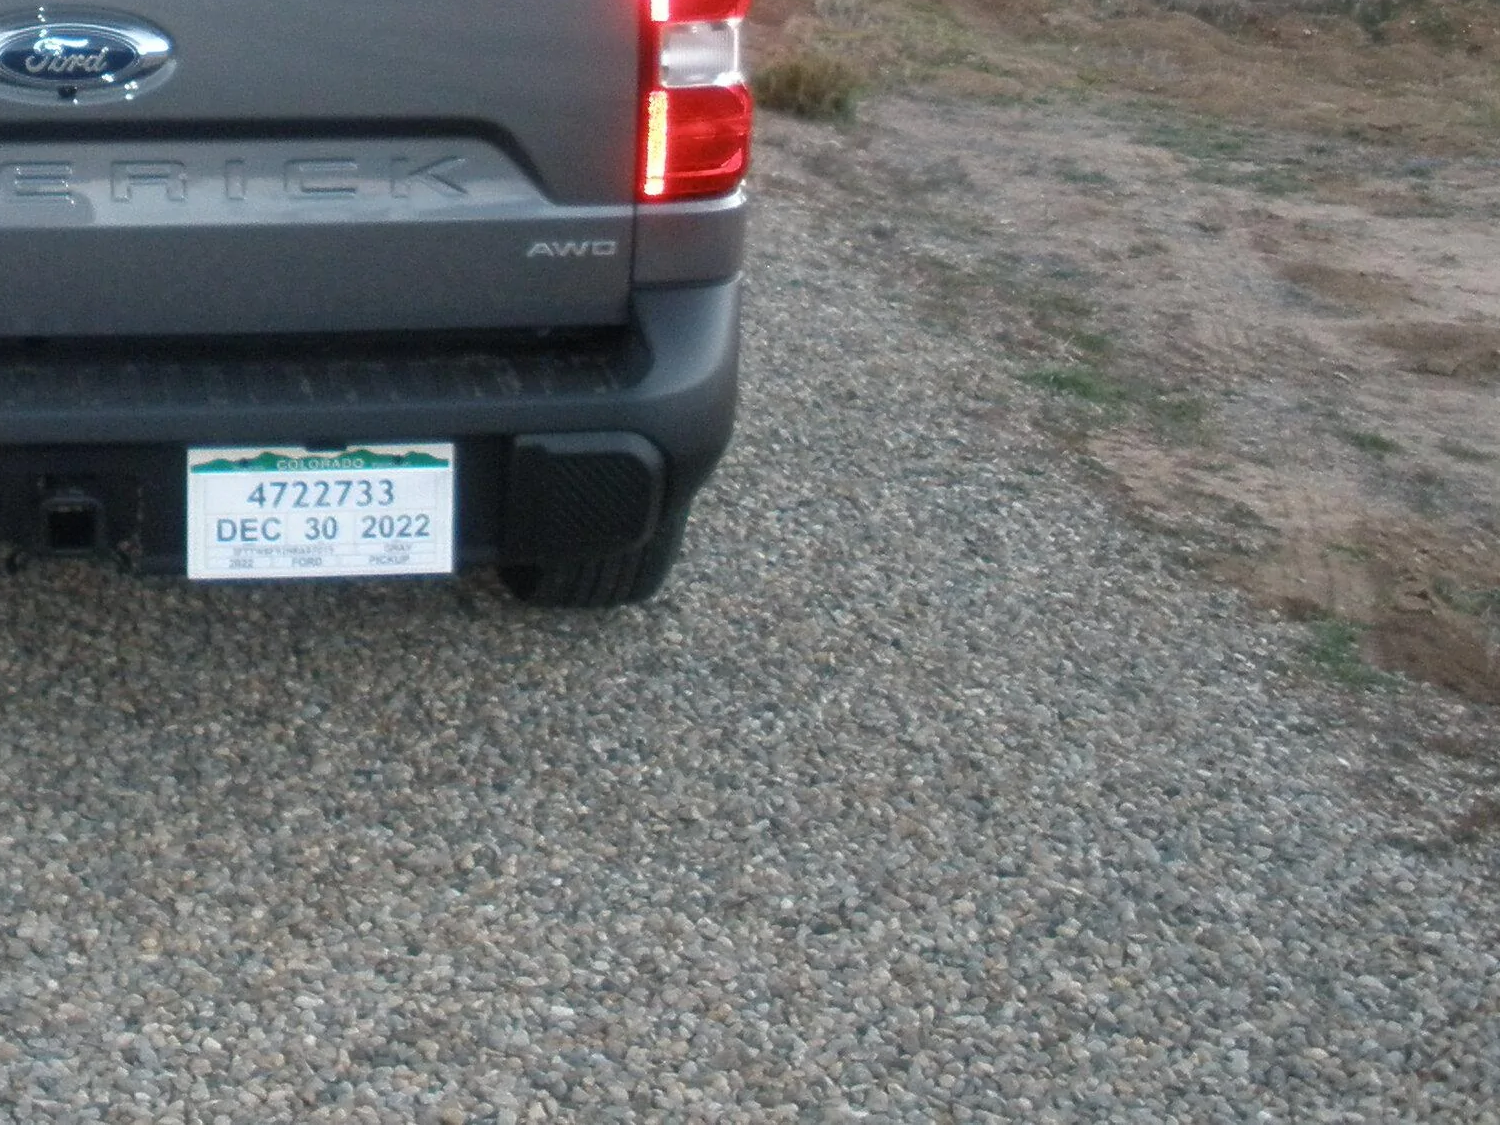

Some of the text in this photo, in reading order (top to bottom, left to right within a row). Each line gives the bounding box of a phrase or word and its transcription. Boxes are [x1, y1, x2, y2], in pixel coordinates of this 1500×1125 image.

[25, 36, 111, 74] Ford
[527, 239, 617, 258] AWD
[276, 457, 365, 472] COLORADO
[246, 478, 395, 509] 4722733
[216, 513, 432, 543] DEC 30 2022
